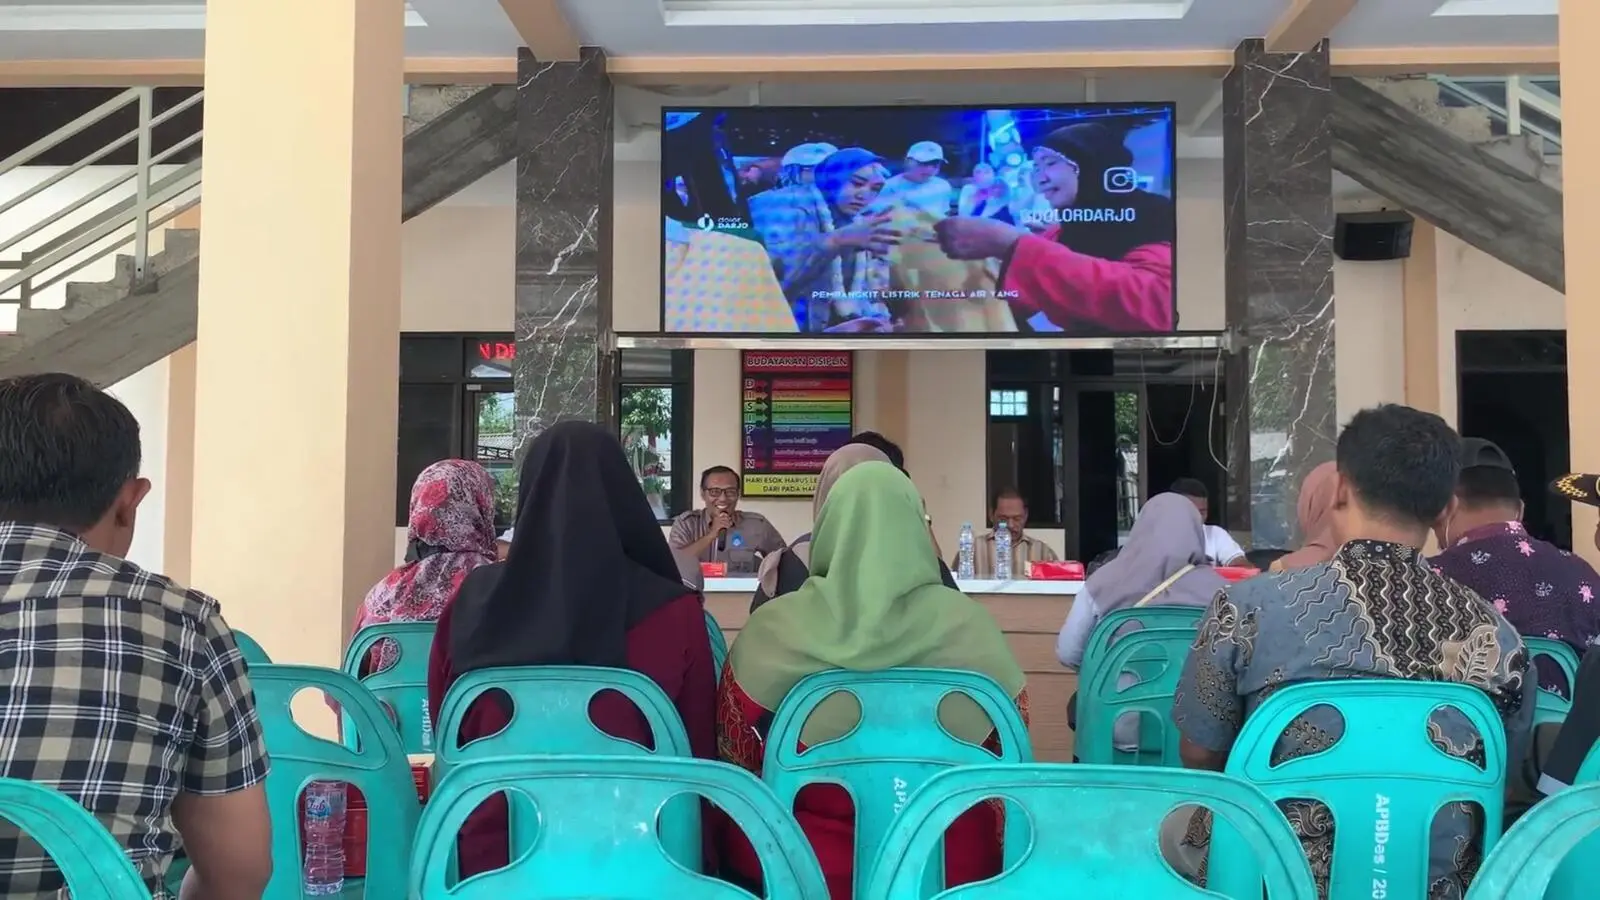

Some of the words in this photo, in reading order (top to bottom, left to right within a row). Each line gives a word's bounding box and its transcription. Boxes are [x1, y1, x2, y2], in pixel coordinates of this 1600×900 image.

[811, 290, 879, 299] PEMBANGKIT
[881, 290, 921, 299] LISTRIK
[924, 290, 967, 299] TENAGA
[969, 290, 986, 299] AIR
[990, 290, 1020, 299] YANG
[747, 356, 807, 367] BUDAYAKAN
[807, 356, 848, 367] DISIPLIN
[764, 476, 783, 484] ESOK
[784, 476, 809, 484] HARUS
[762, 485, 780, 493] DARI
[781, 485, 801, 493] PADA
[1374, 793, 1390, 864] APBDes
